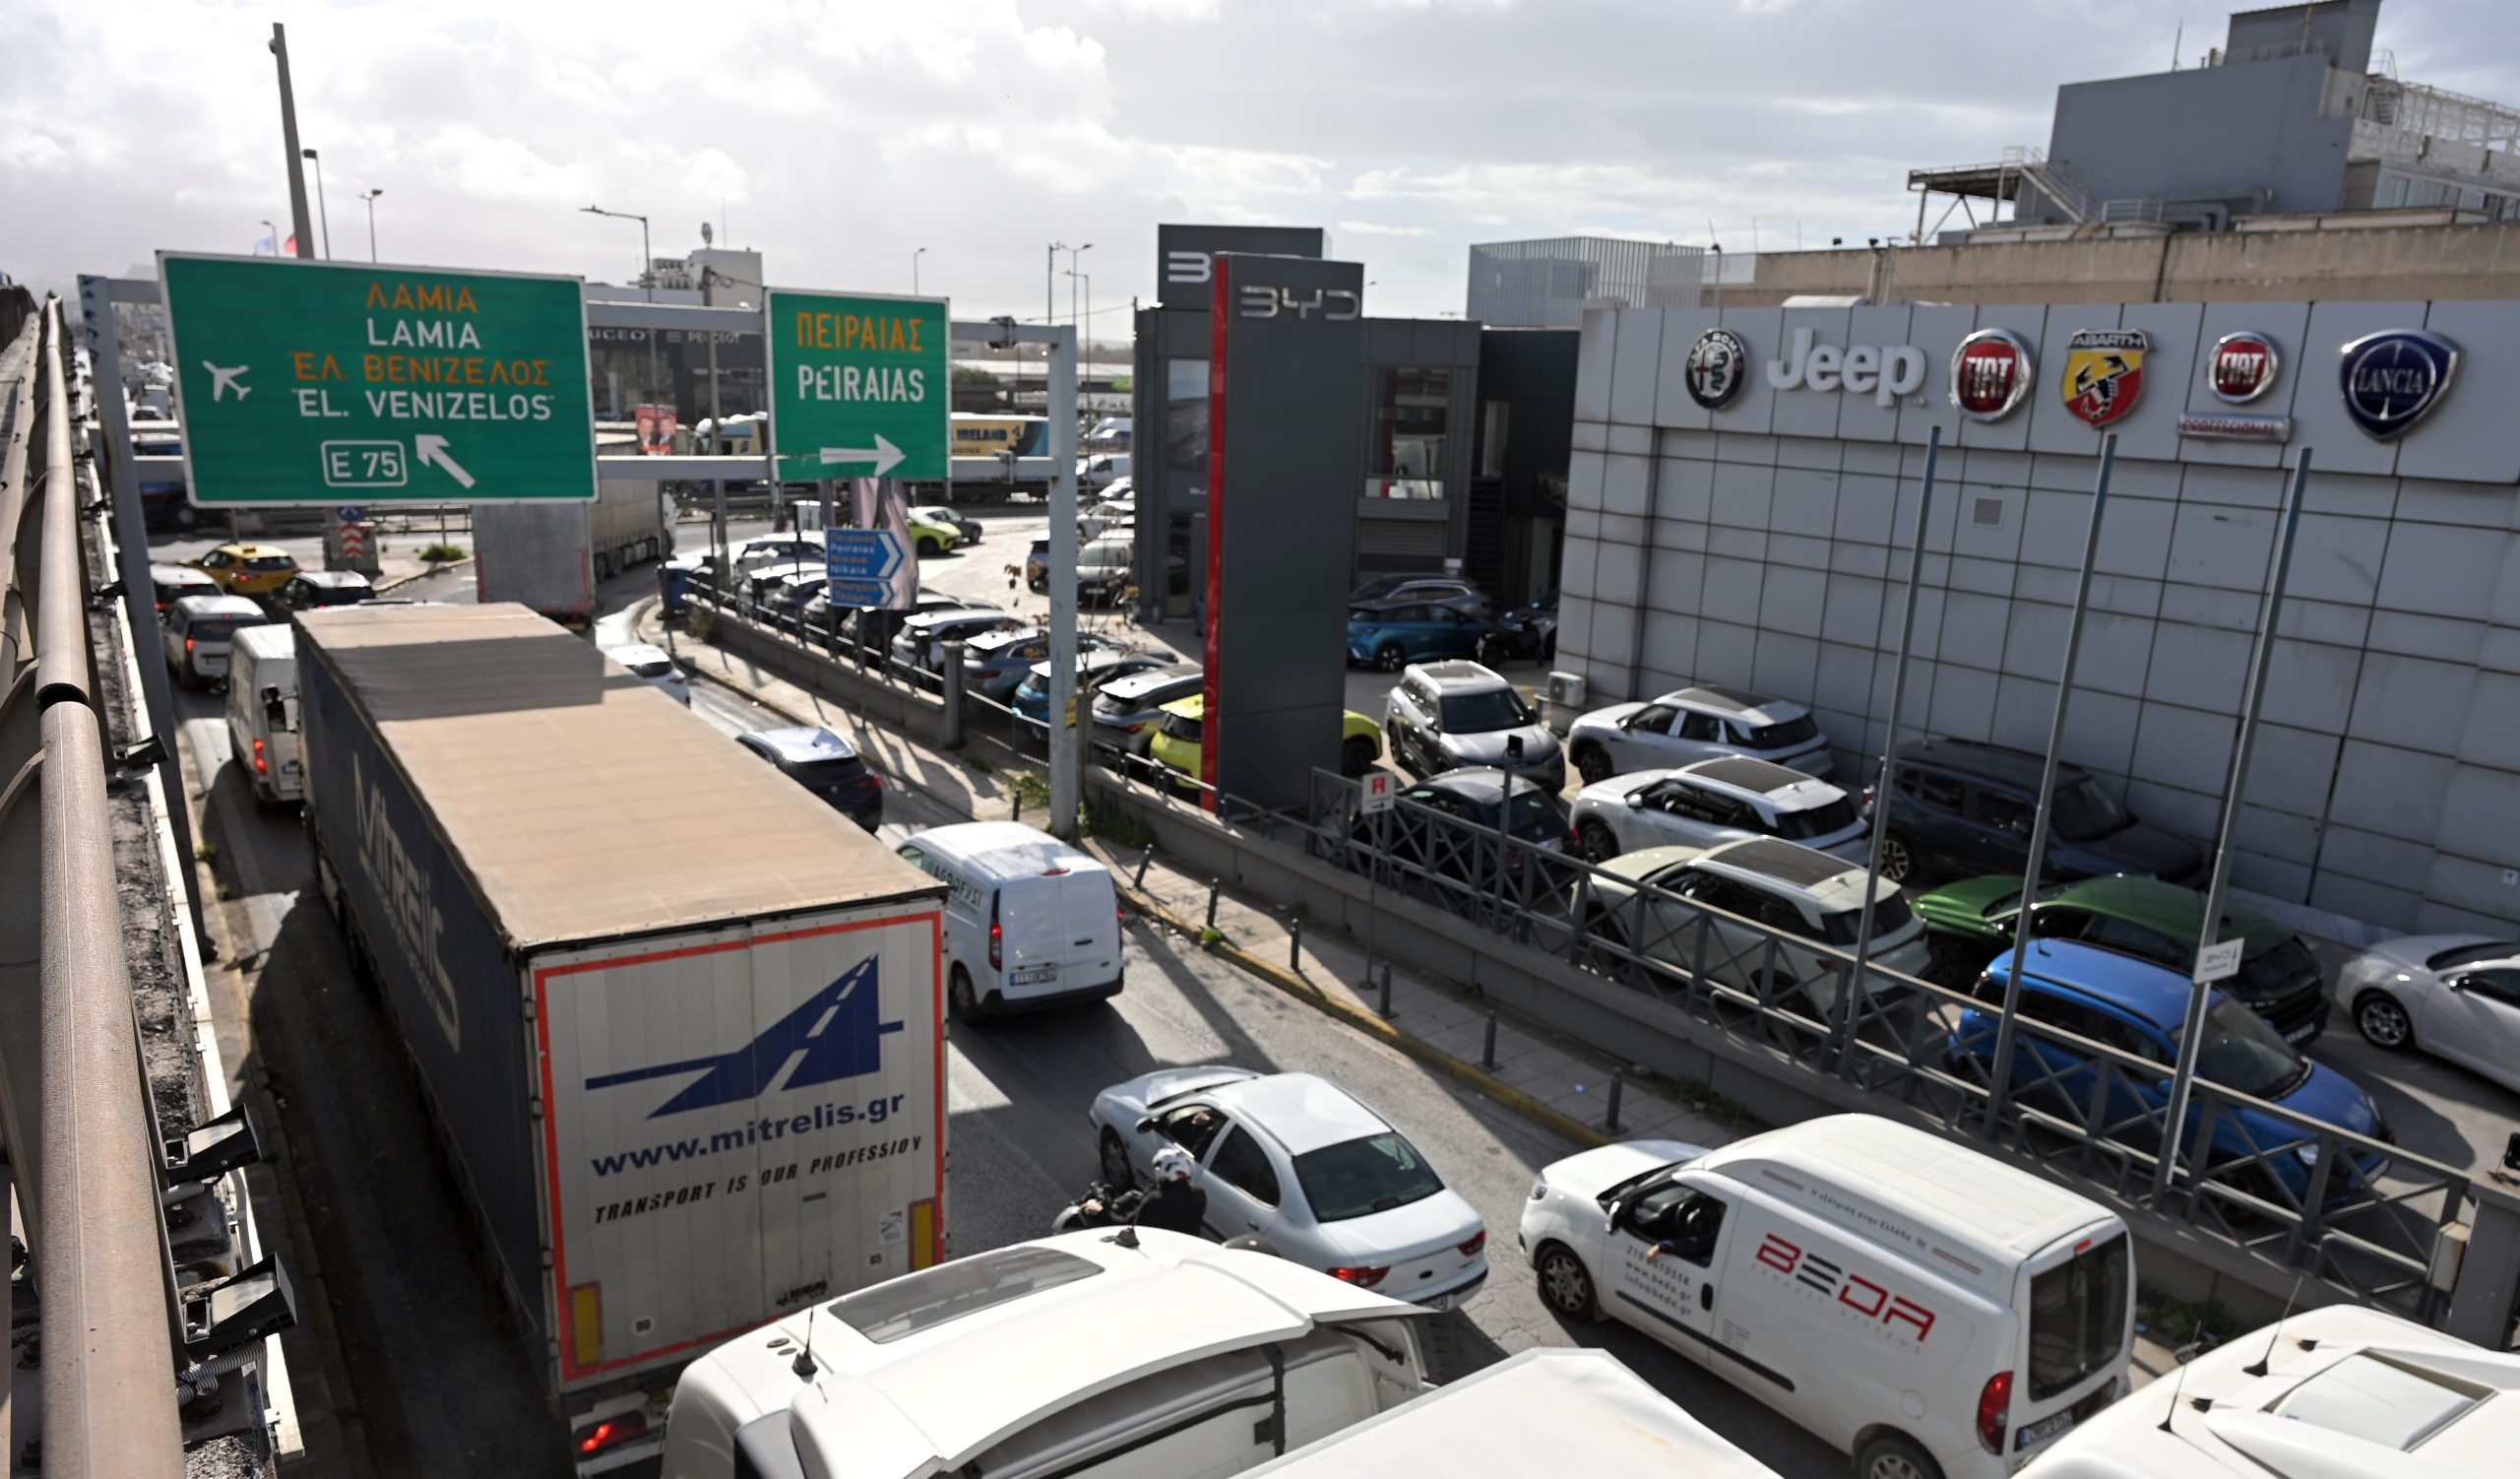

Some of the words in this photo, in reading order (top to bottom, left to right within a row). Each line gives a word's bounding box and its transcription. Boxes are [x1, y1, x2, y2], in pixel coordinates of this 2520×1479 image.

[366, 282, 478, 313] ΛΑΜΙΑ
[1240, 286, 1359, 321] BYD
[367, 318, 480, 350] LAMIA
[796, 311, 923, 353] ΠΕΙΡΑΙΑΣ
[2074, 334, 2143, 347] ABARTH
[798, 364, 924, 402] PEIRAIAS
[1767, 327, 1926, 407] Jeep
[1966, 356, 2014, 399] FIAT
[2219, 352, 2264, 386] FIAT
[2358, 367, 2424, 394] LANCIA
[2181, 418, 2276, 436] PROFESSIONAL
[330, 451, 351, 479] E
[362, 451, 399, 479] 75
[592, 1094, 905, 1178] www.mitrelis.gr
[595, 1183, 716, 1224] TRANSPORT
[726, 1176, 747, 1193] IS
[761, 1164, 797, 1186] OUR
[1756, 1233, 1935, 1342] BEDA
